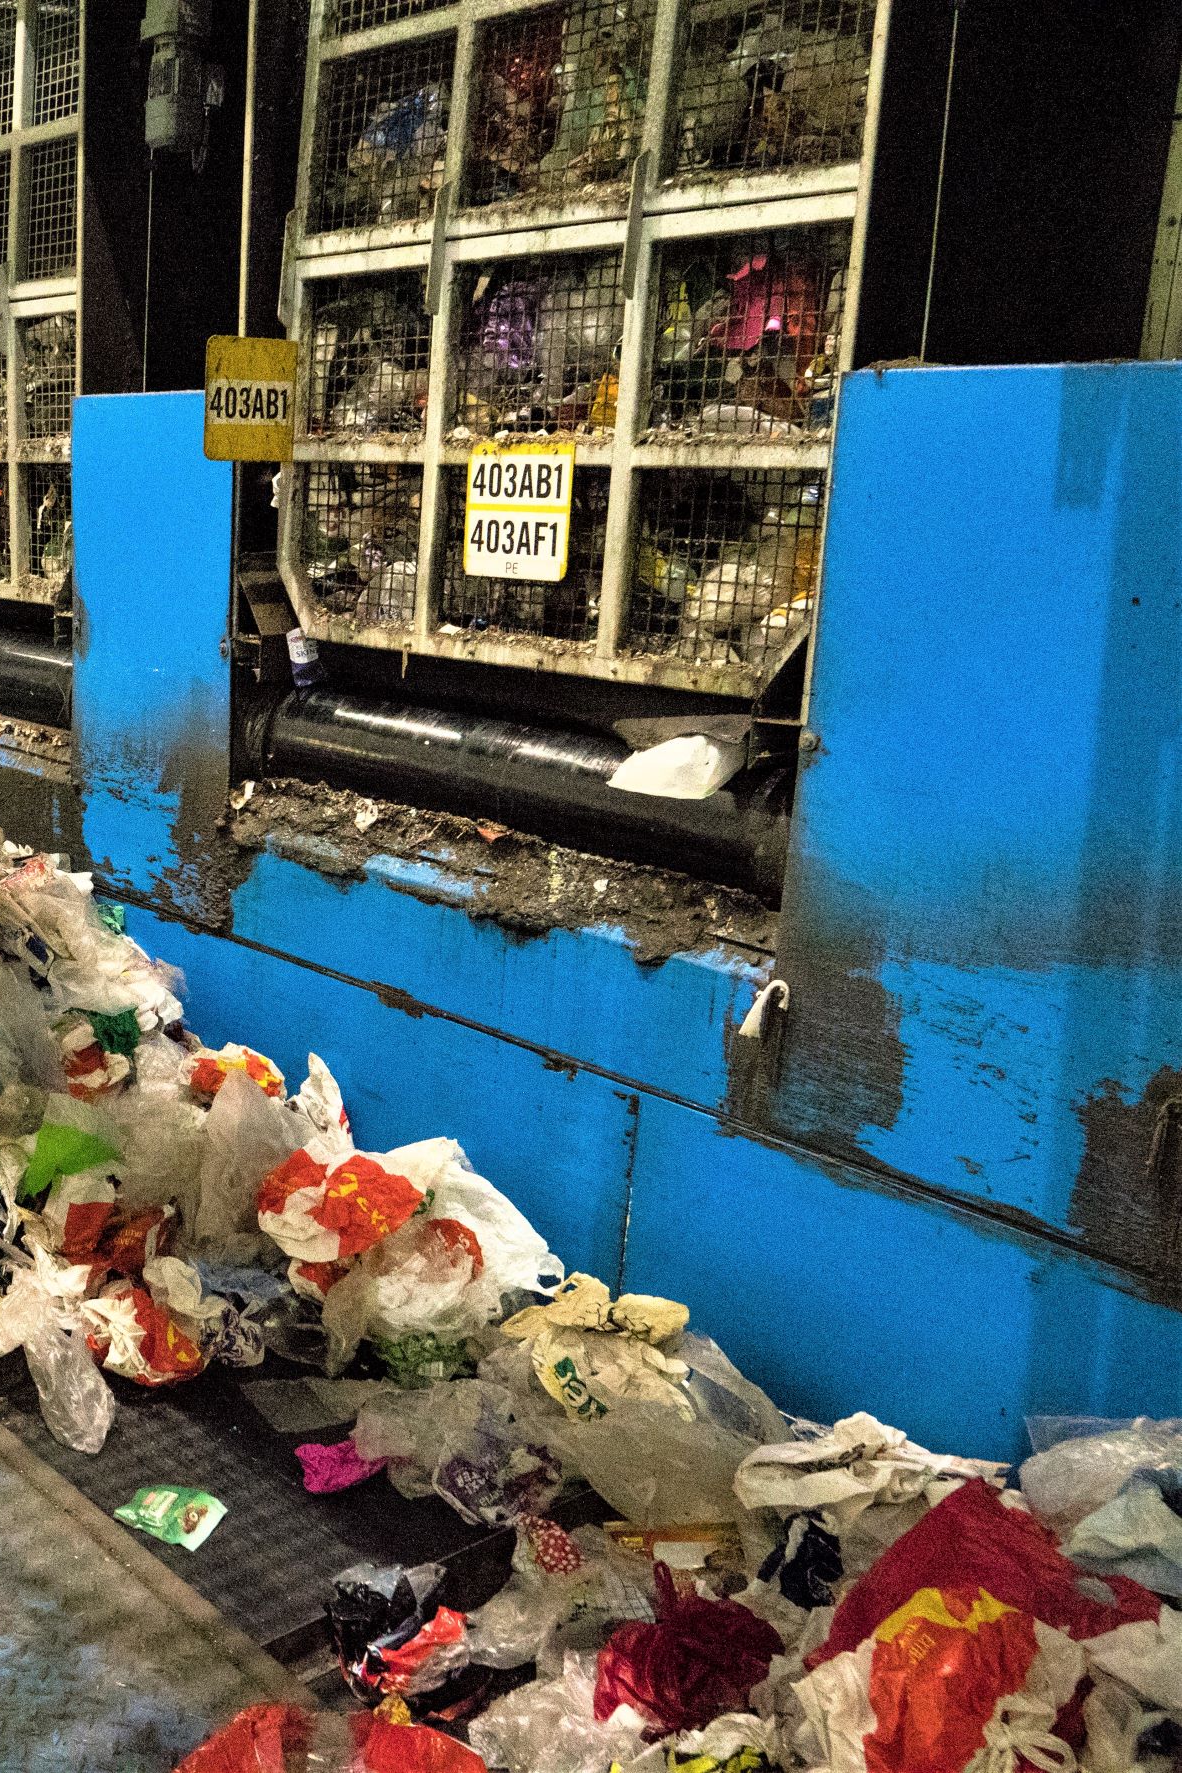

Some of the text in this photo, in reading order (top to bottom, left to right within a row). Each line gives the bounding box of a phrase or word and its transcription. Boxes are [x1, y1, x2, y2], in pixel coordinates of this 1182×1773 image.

[210, 387, 288, 419] 403AB1
[472, 463, 563, 499] 403AB1
[470, 519, 558, 557] 403AF1
[505, 561, 519, 574] PE
